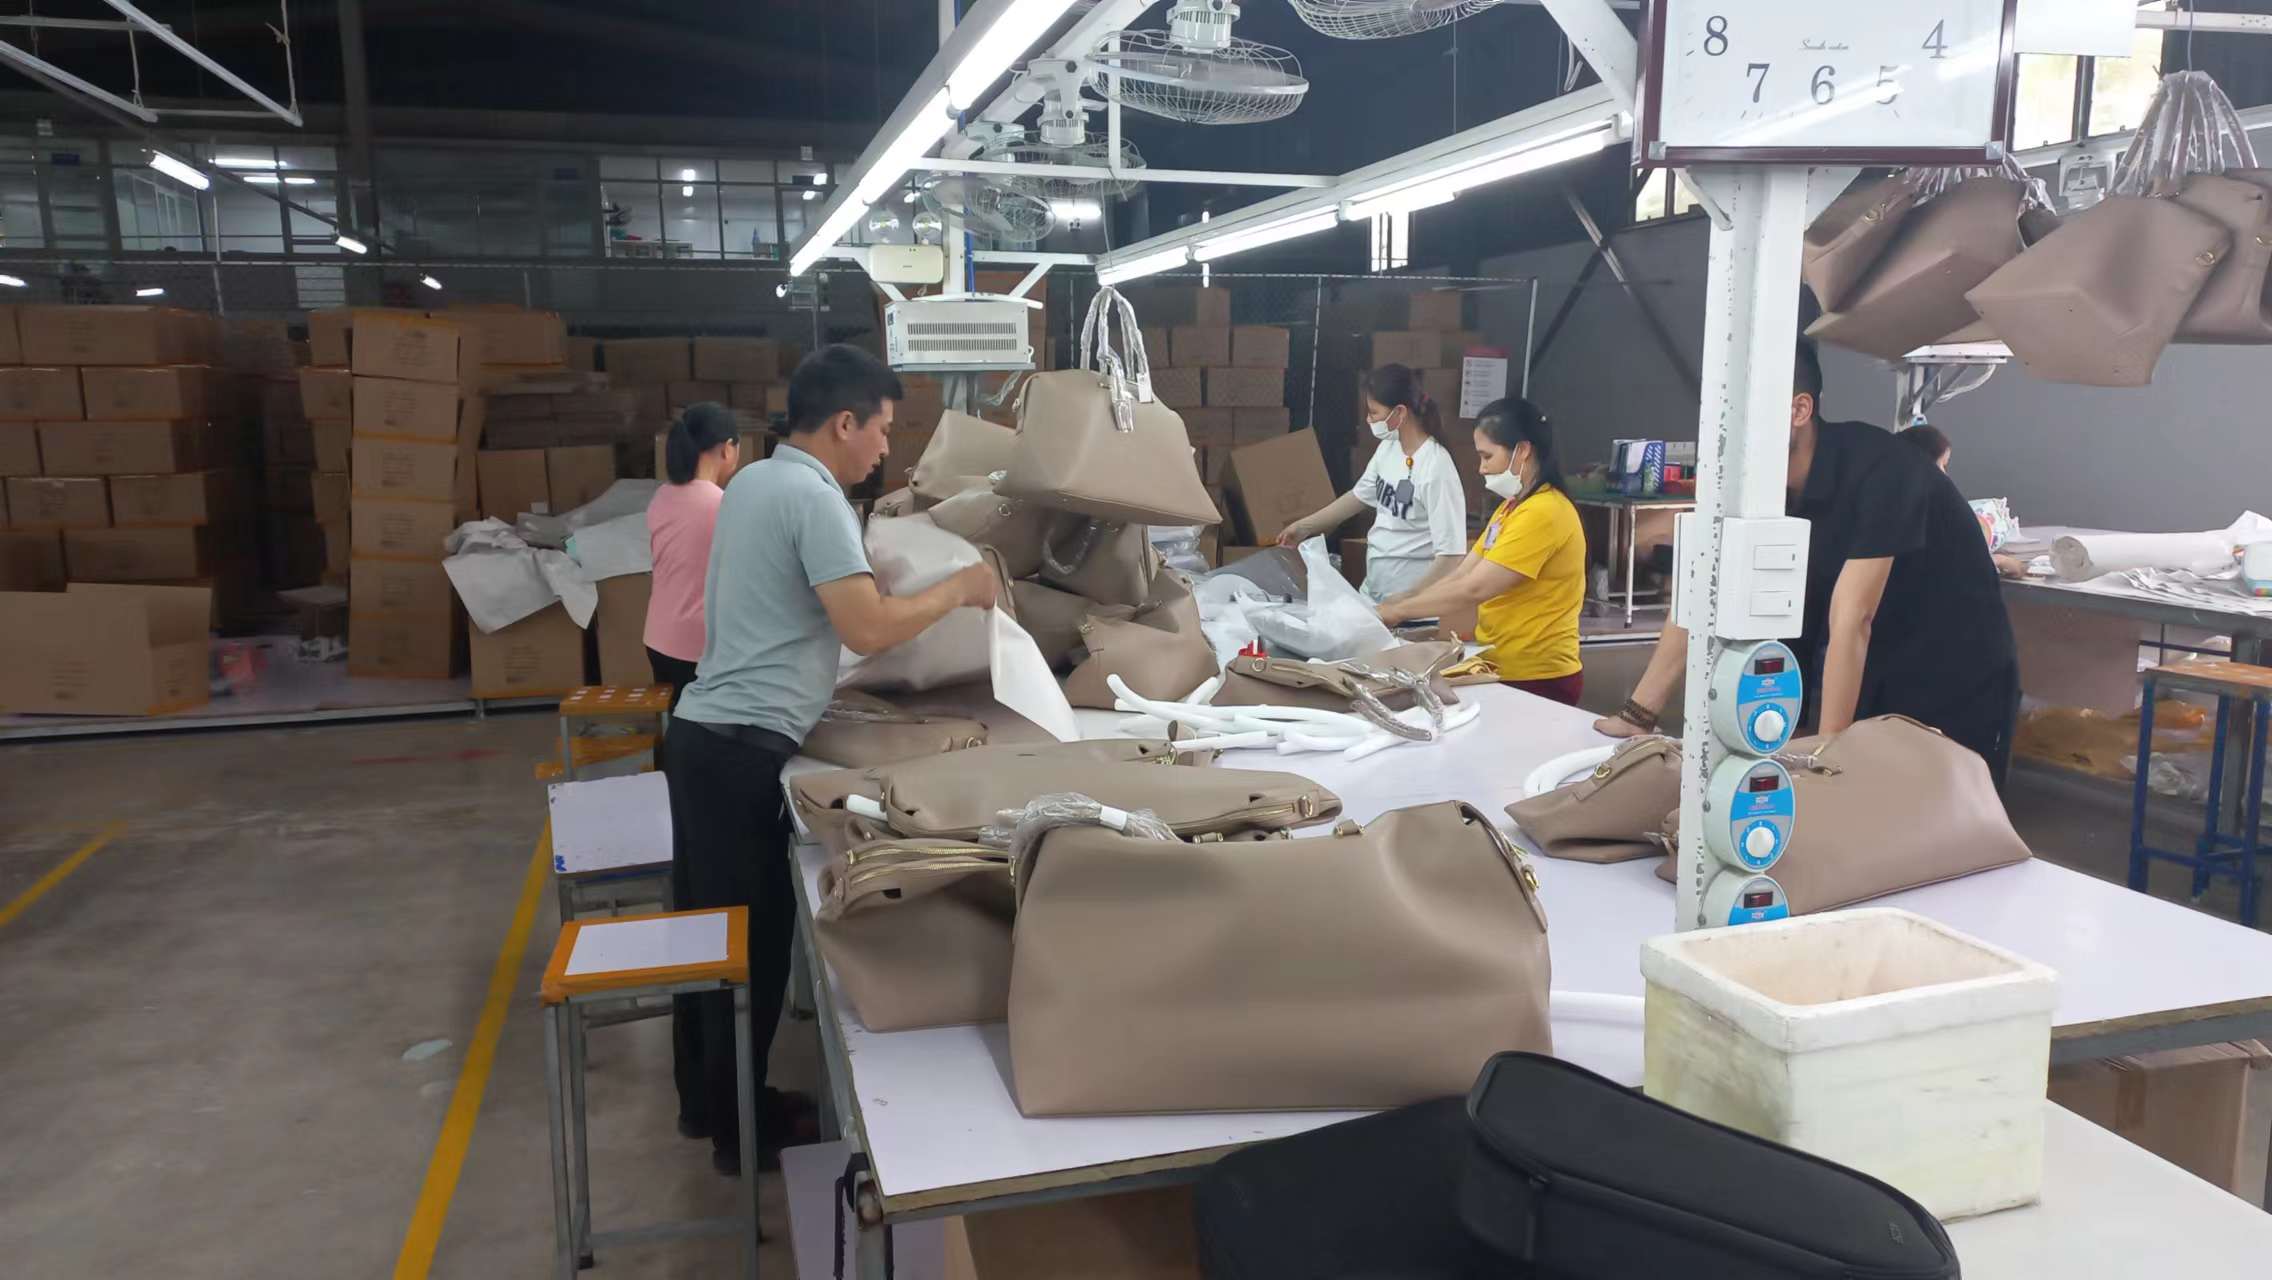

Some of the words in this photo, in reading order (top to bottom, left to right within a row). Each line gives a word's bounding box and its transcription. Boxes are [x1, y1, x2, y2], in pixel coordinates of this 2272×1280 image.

[1703, 15, 1729, 57] 8
[1921, 18, 1948, 59] 4
[1746, 63, 1770, 104] 7
[1810, 65, 1836, 105] 6
[1876, 65, 1899, 105] 5
